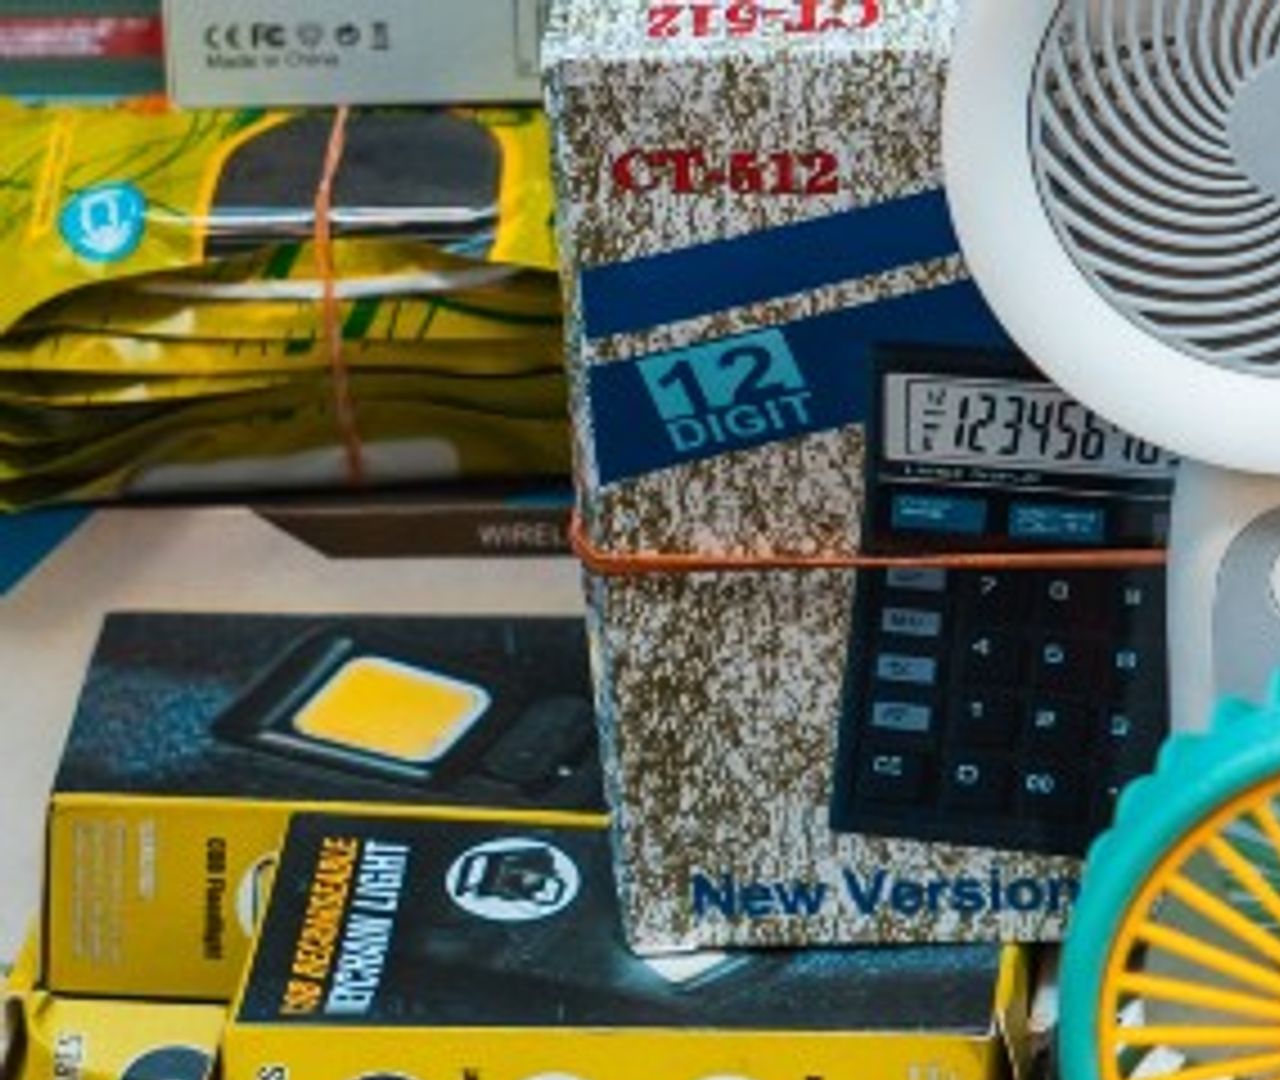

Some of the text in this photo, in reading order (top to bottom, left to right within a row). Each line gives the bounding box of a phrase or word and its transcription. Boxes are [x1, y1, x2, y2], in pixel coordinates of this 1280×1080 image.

[611, 149, 841, 194] CT-512
[657, 346, 788, 421] 12
[667, 391, 812, 451] DIGIT
[352, 839, 411, 912] LIGHT
[690, 864, 1082, 917] New Version
